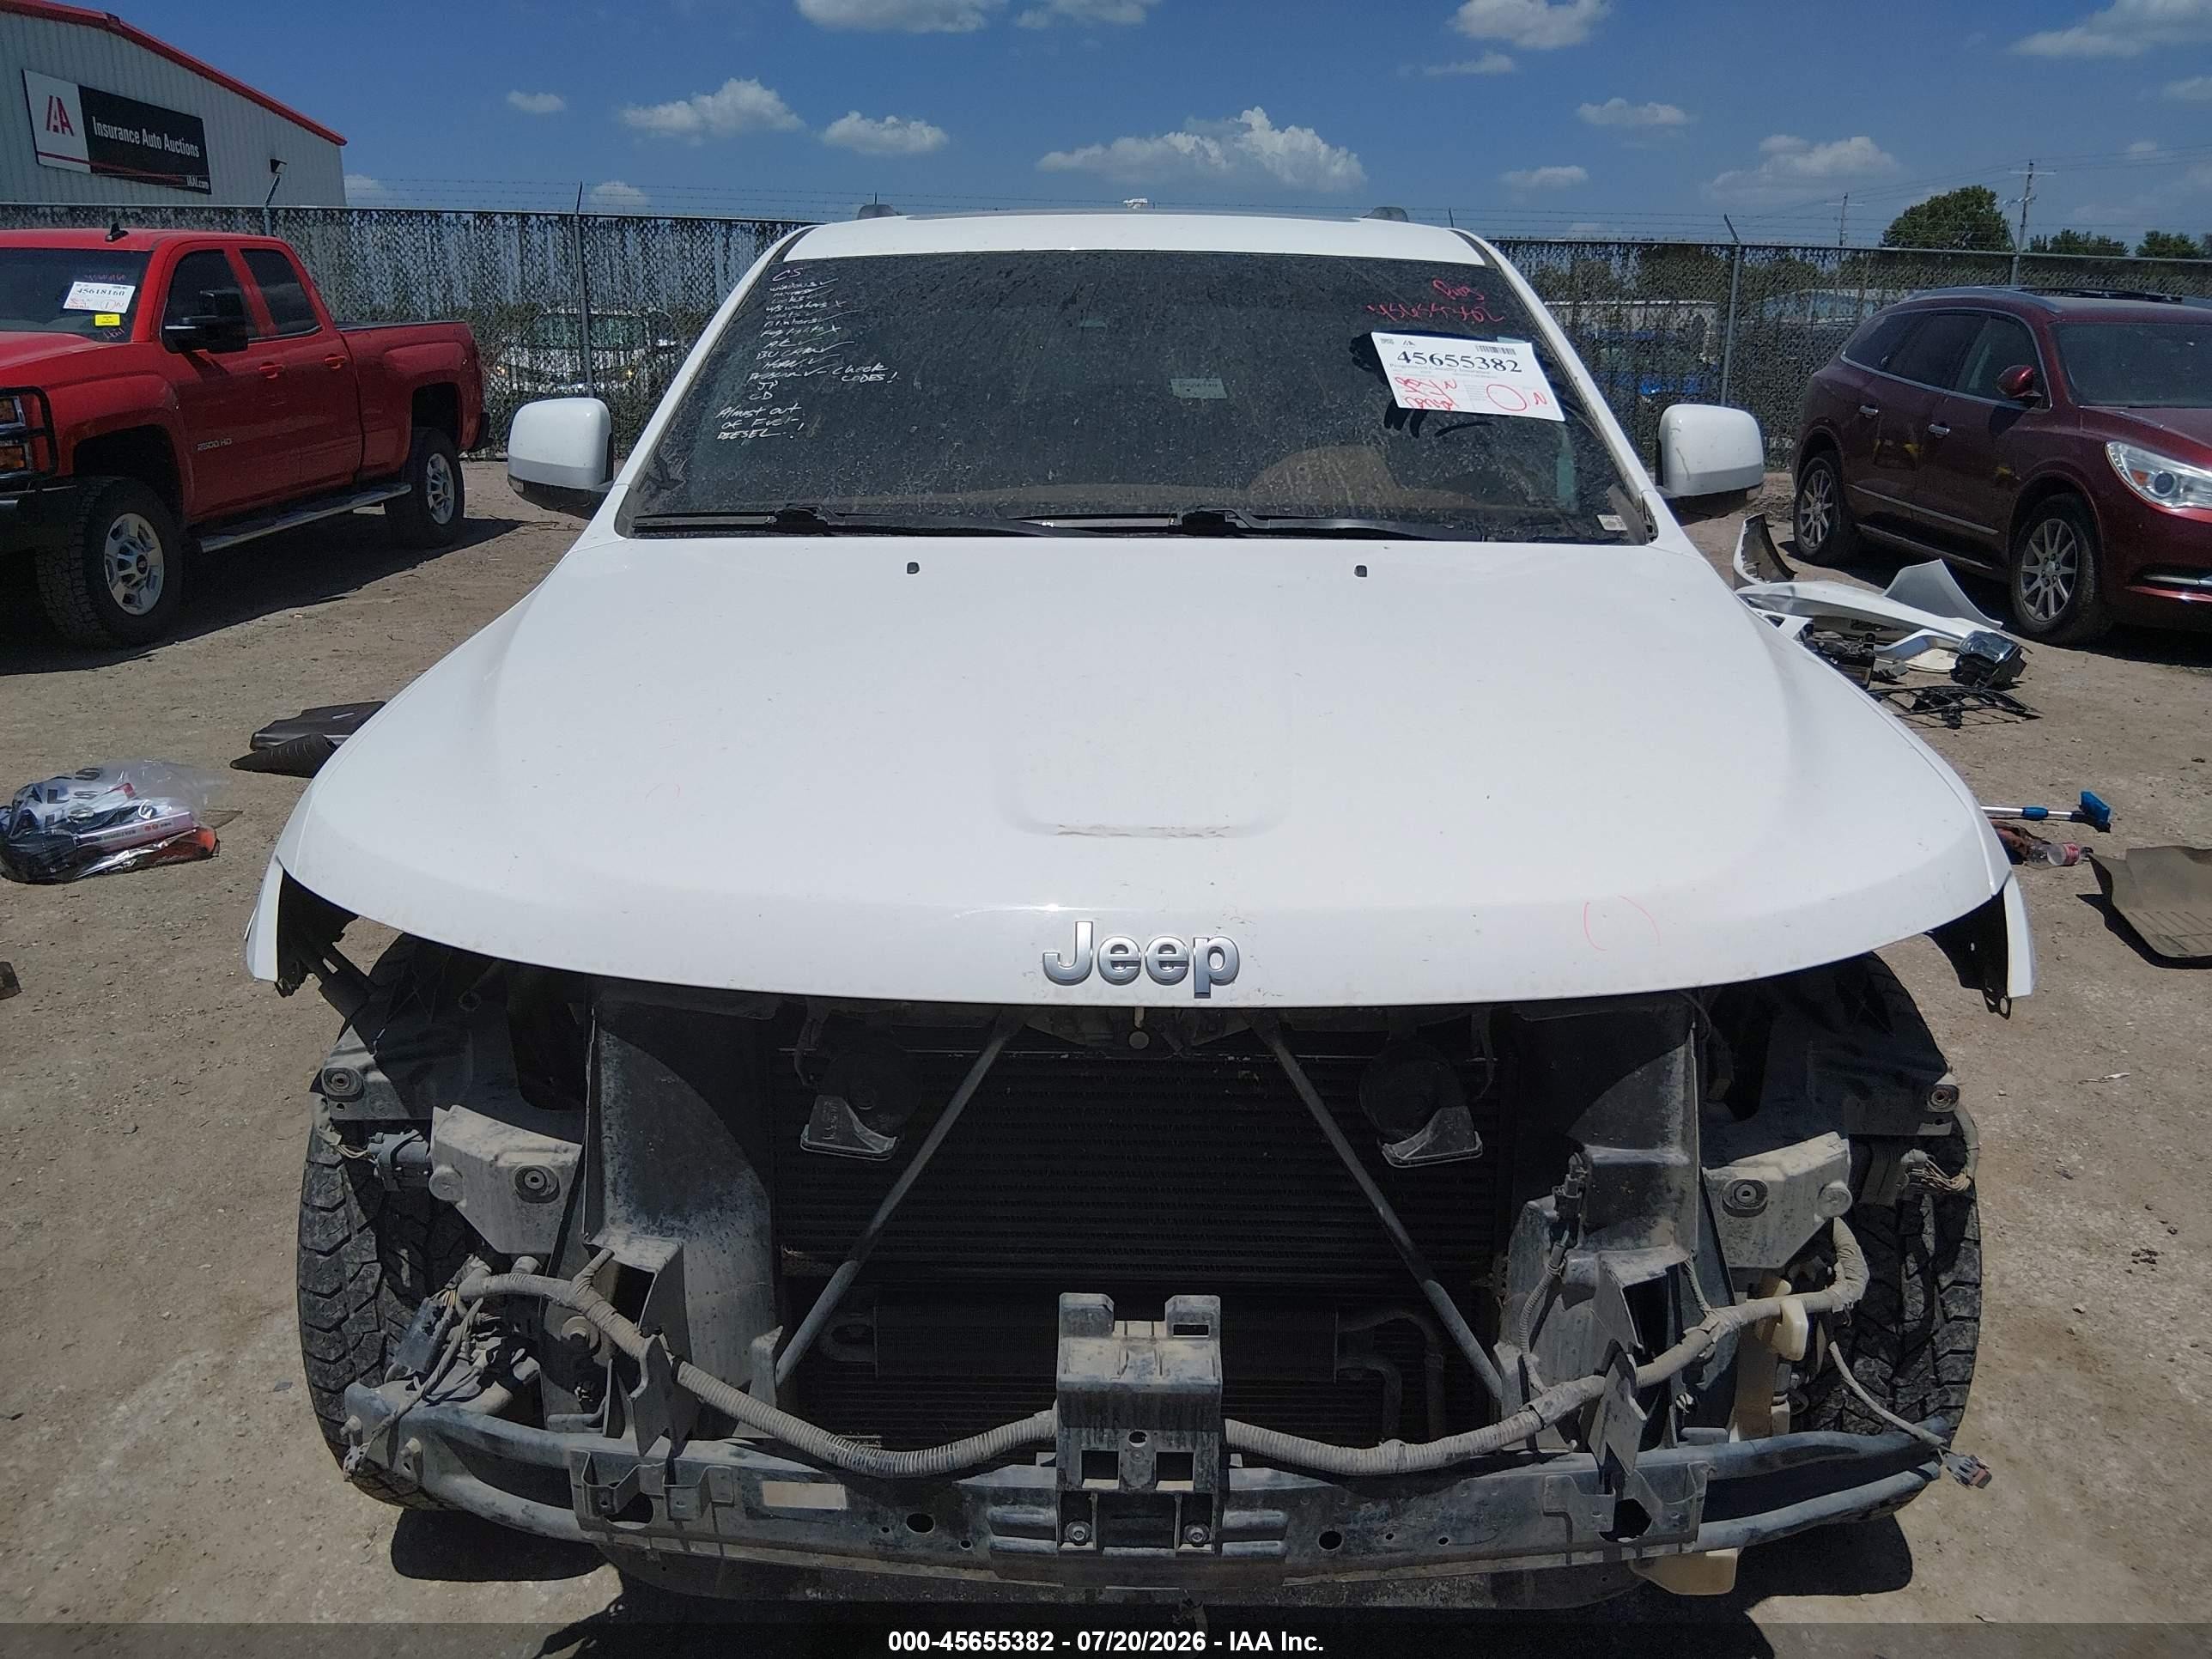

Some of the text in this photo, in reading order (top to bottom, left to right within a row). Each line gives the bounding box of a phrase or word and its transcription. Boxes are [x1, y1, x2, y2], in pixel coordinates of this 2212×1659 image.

[92, 116, 200, 158] Insurance Auto Auctions
[1397, 350, 1522, 373] 45655382
[1042, 921, 1240, 999] Jeep
